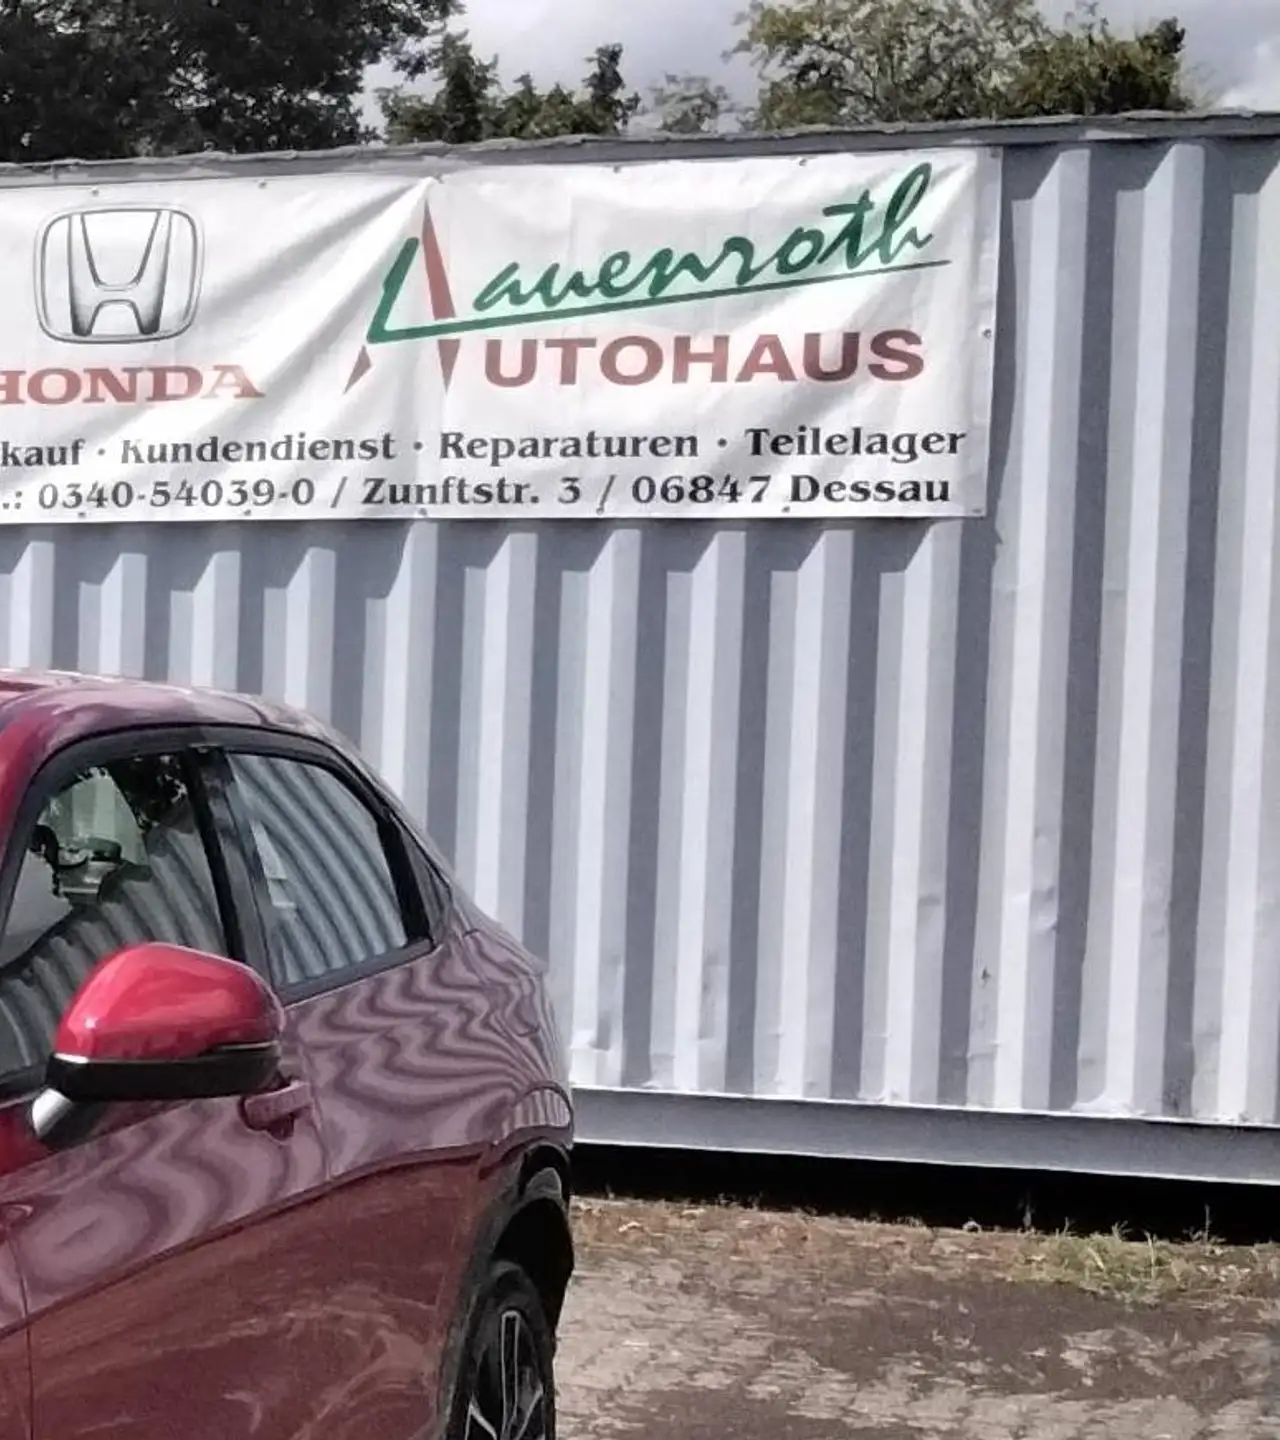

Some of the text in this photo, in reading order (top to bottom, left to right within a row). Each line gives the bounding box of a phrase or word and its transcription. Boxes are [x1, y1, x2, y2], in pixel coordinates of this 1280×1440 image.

[366, 162, 952, 344] Lauenroth
[120, 431, 397, 466] Kundendienst
[439, 431, 699, 468] Reparaturen
[743, 426, 968, 465] Teilelager
[38, 477, 316, 510] 0340-54039-0
[360, 475, 541, 506] Zunftstr.
[558, 476, 582, 505] 3
[631, 475, 772, 505] 06847
[788, 473, 952, 504] Dessau
